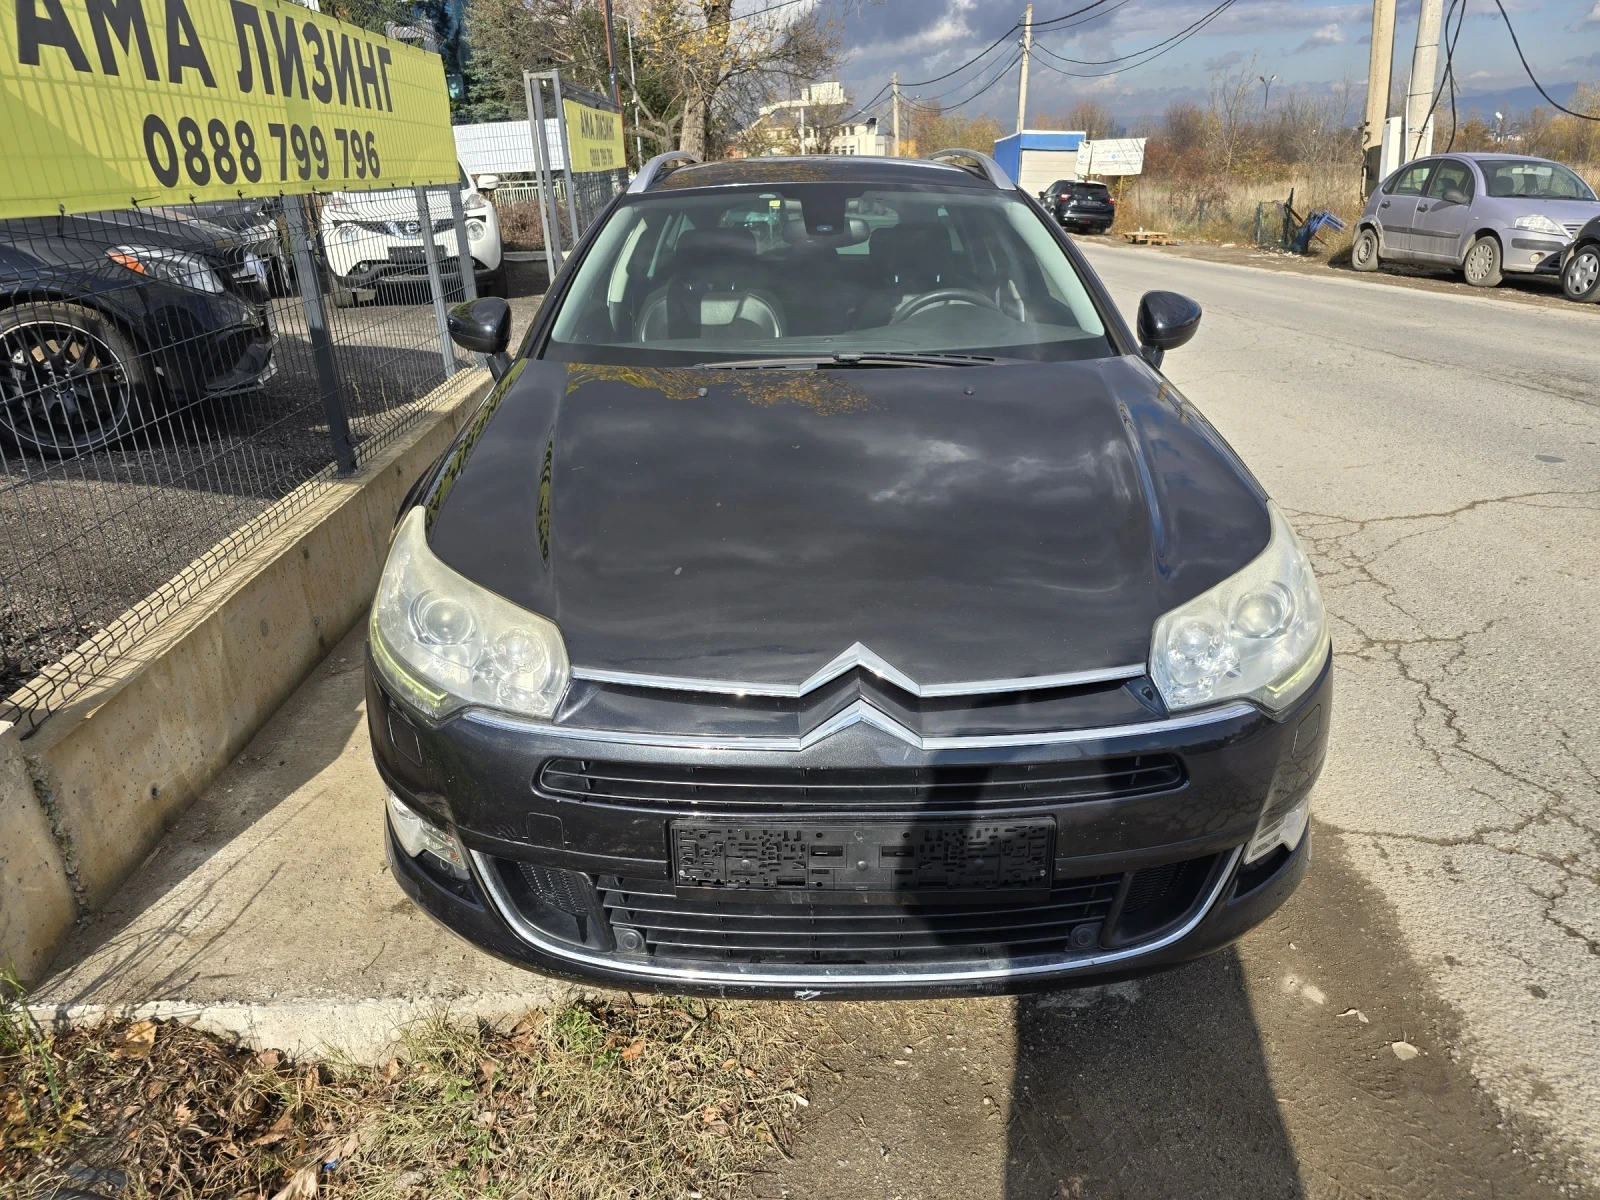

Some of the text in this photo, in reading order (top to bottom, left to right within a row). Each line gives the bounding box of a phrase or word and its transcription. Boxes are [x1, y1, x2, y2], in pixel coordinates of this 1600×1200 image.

[16, 0, 393, 113] АМА ЛИЗИНГ
[143, 113, 381, 188] 0888 799 796
